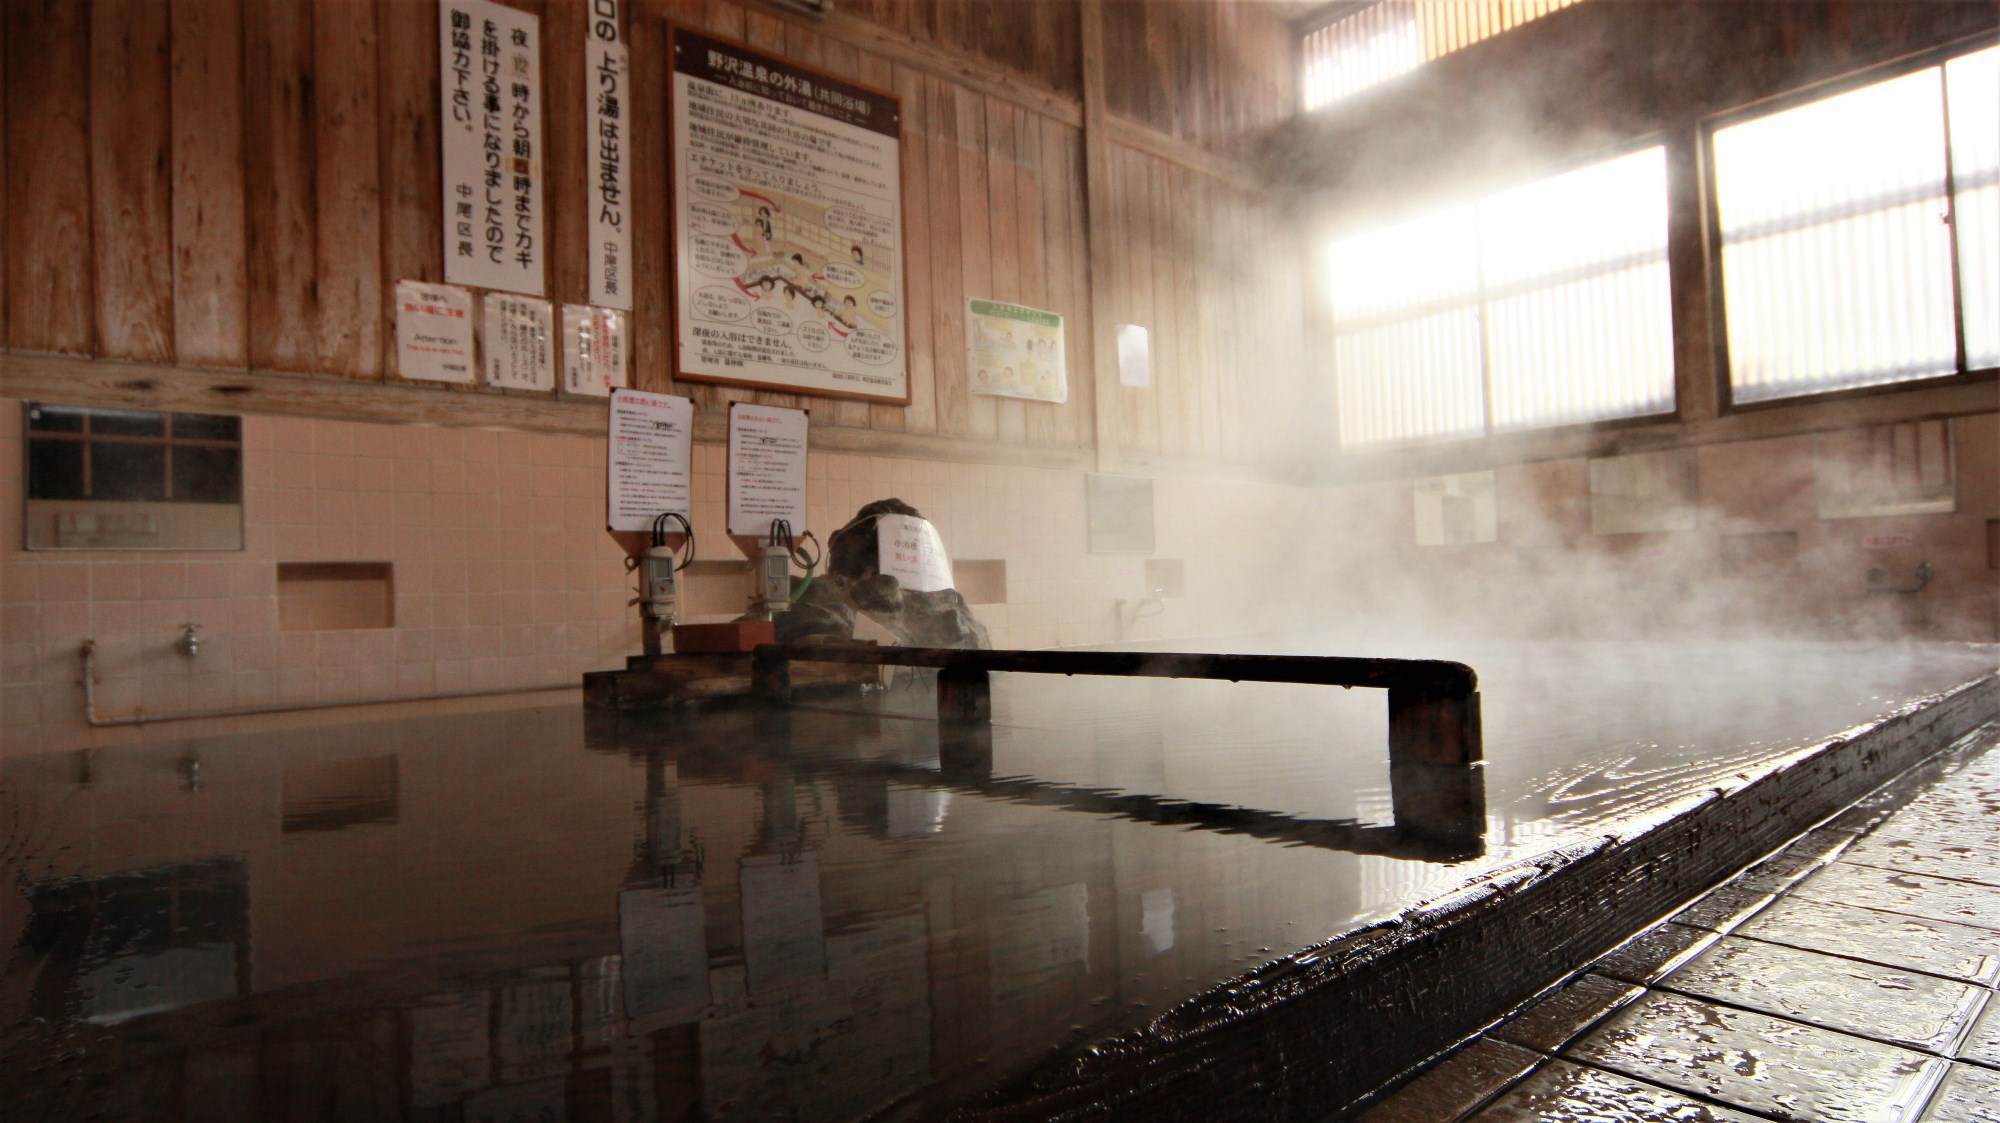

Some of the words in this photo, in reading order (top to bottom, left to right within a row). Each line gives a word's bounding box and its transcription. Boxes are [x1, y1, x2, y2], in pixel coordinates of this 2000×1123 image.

[450, 8, 473, 133] 御協力下さい。
[480, 19, 505, 264] を掛ける事になりましたので
[689, 154, 822, 194] エチケットを守って入りましょう。
[455, 183, 474, 258] 中尾区長
[602, 241, 620, 296] 中尾区長
[692, 326, 794, 350] 深夜の入浴はできません。
